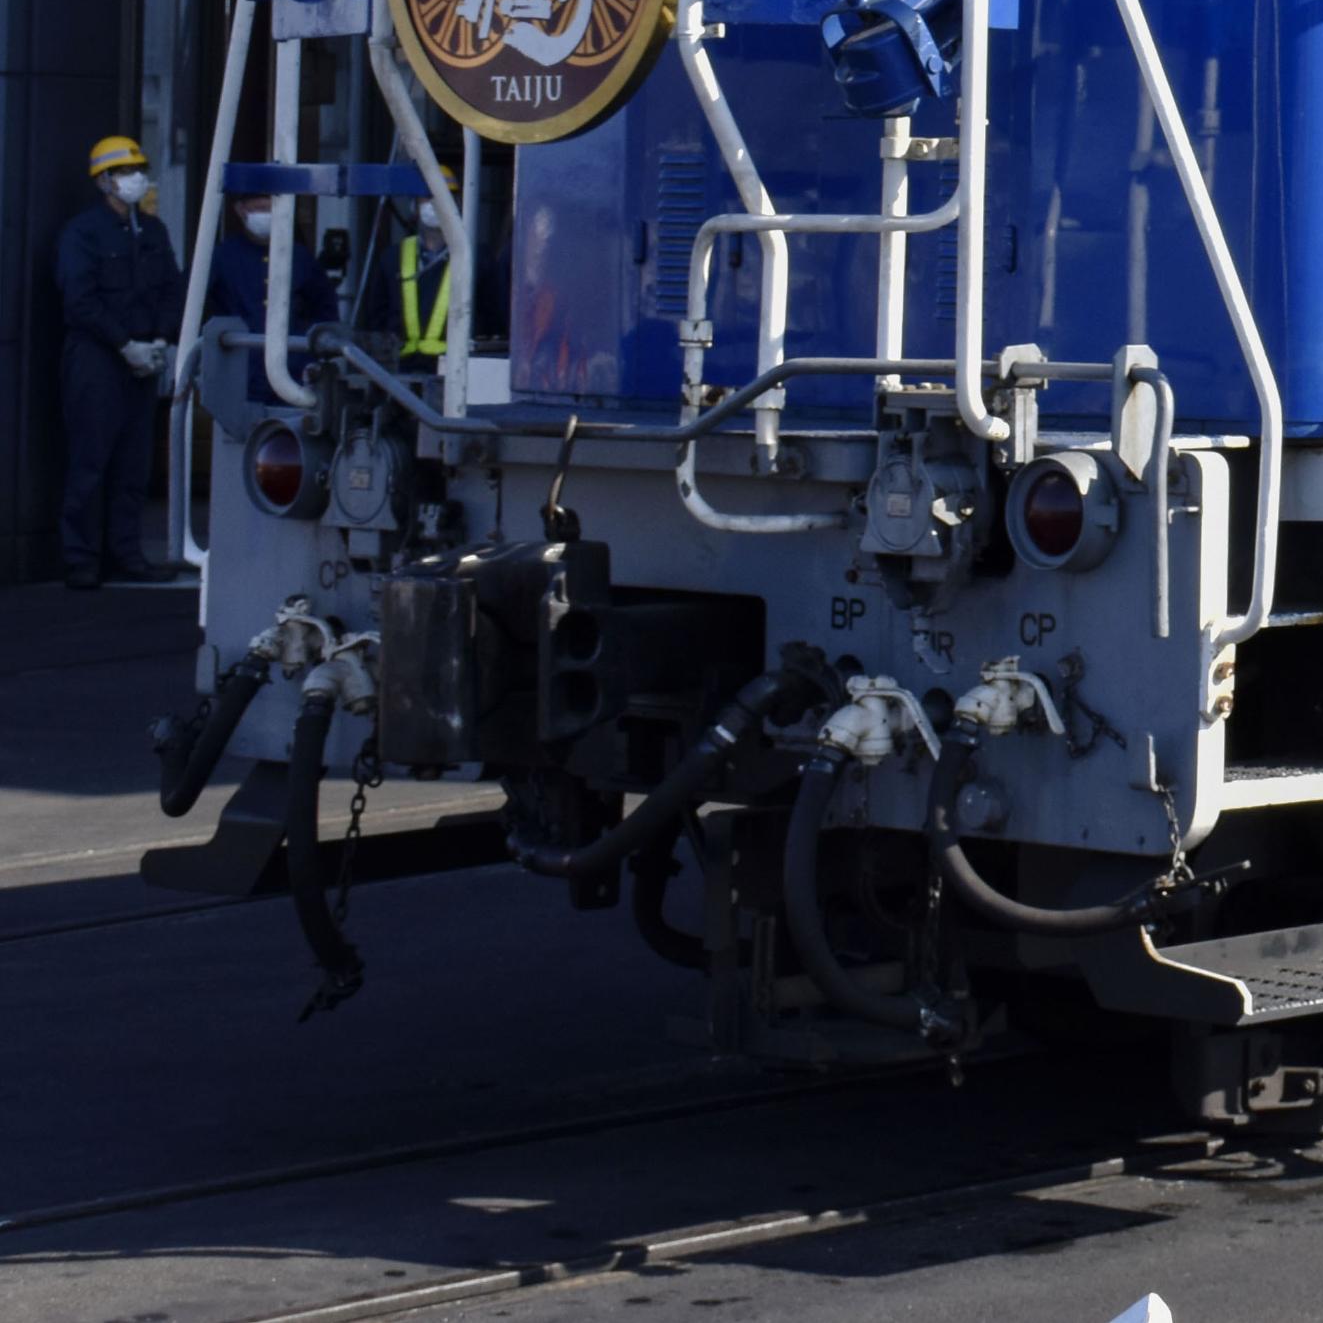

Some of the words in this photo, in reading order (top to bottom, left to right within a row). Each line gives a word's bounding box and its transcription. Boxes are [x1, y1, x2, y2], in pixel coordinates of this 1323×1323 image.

[490, 74, 563, 109] TAIJU
[319, 560, 349, 591] CP
[830, 596, 866, 631] BP
[1019, 613, 1057, 646] CP
